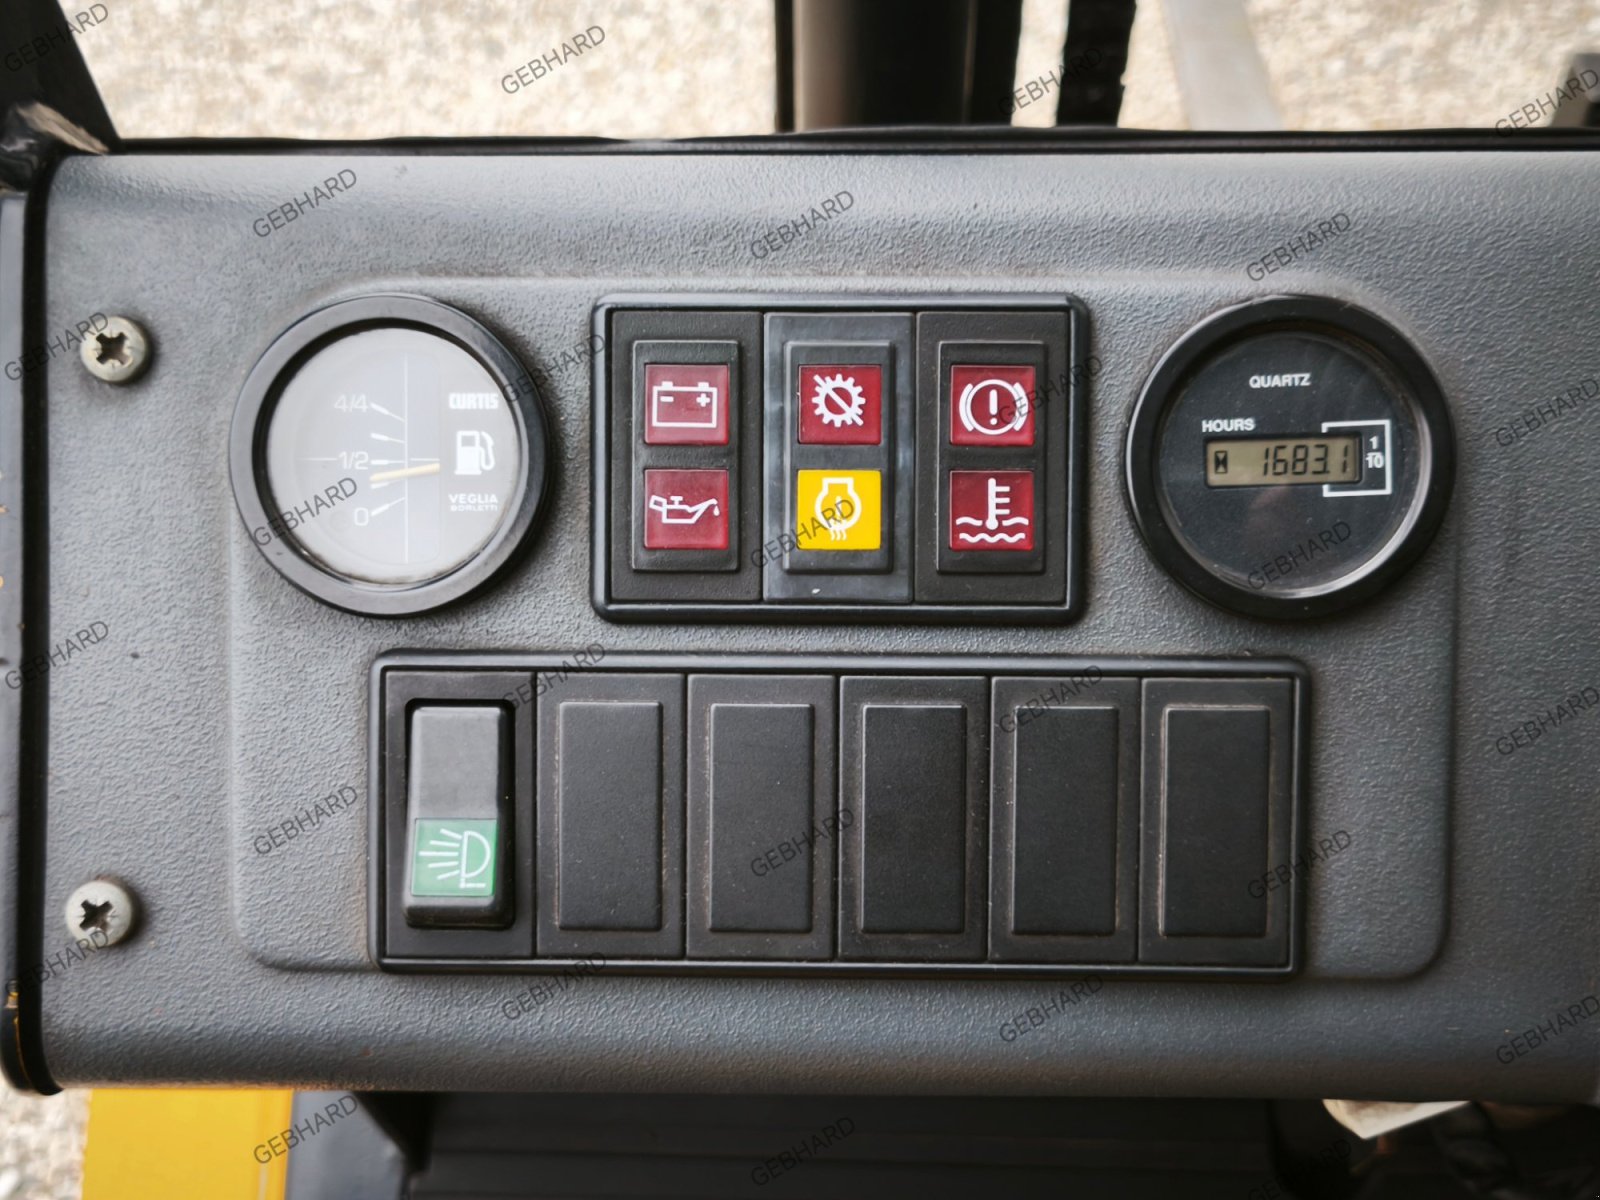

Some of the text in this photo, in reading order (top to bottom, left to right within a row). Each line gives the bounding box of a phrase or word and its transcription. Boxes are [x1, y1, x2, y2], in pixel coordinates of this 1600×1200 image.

[1249, 373, 1311, 388] QUARTZ
[334, 394, 368, 413] 4/4
[449, 393, 498, 409] CURTIS
[1202, 418, 1256, 432] HOURS
[338, 451, 369, 470] 1/2
[449, 494, 498, 504] VEGLIA
[354, 507, 369, 526] 0
